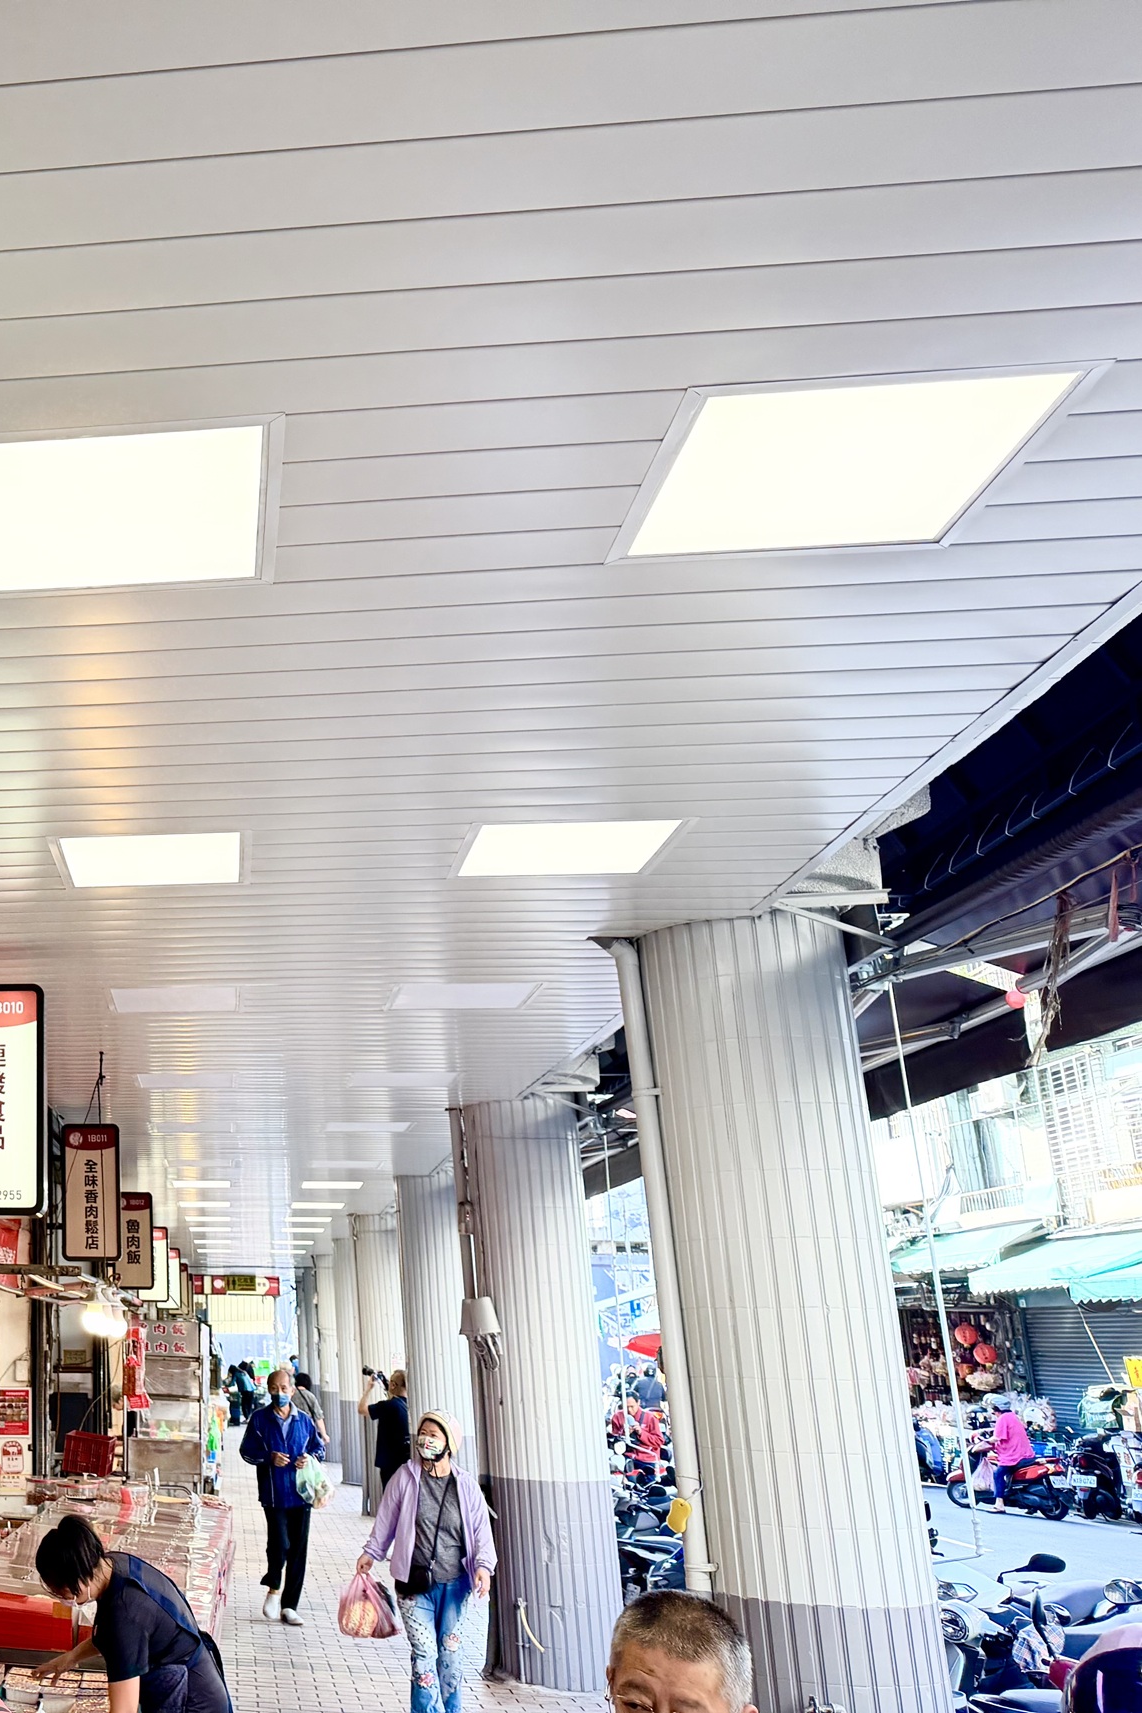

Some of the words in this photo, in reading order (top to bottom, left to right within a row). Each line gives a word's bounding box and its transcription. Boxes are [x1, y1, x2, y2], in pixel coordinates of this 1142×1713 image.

[87, 1134, 108, 1143] 1B011
[84, 1159, 100, 1250] 全味香肉鬆店
[125, 1218, 142, 1265] 魯肉飯
[139, 1322, 186, 1337] 肉飯
